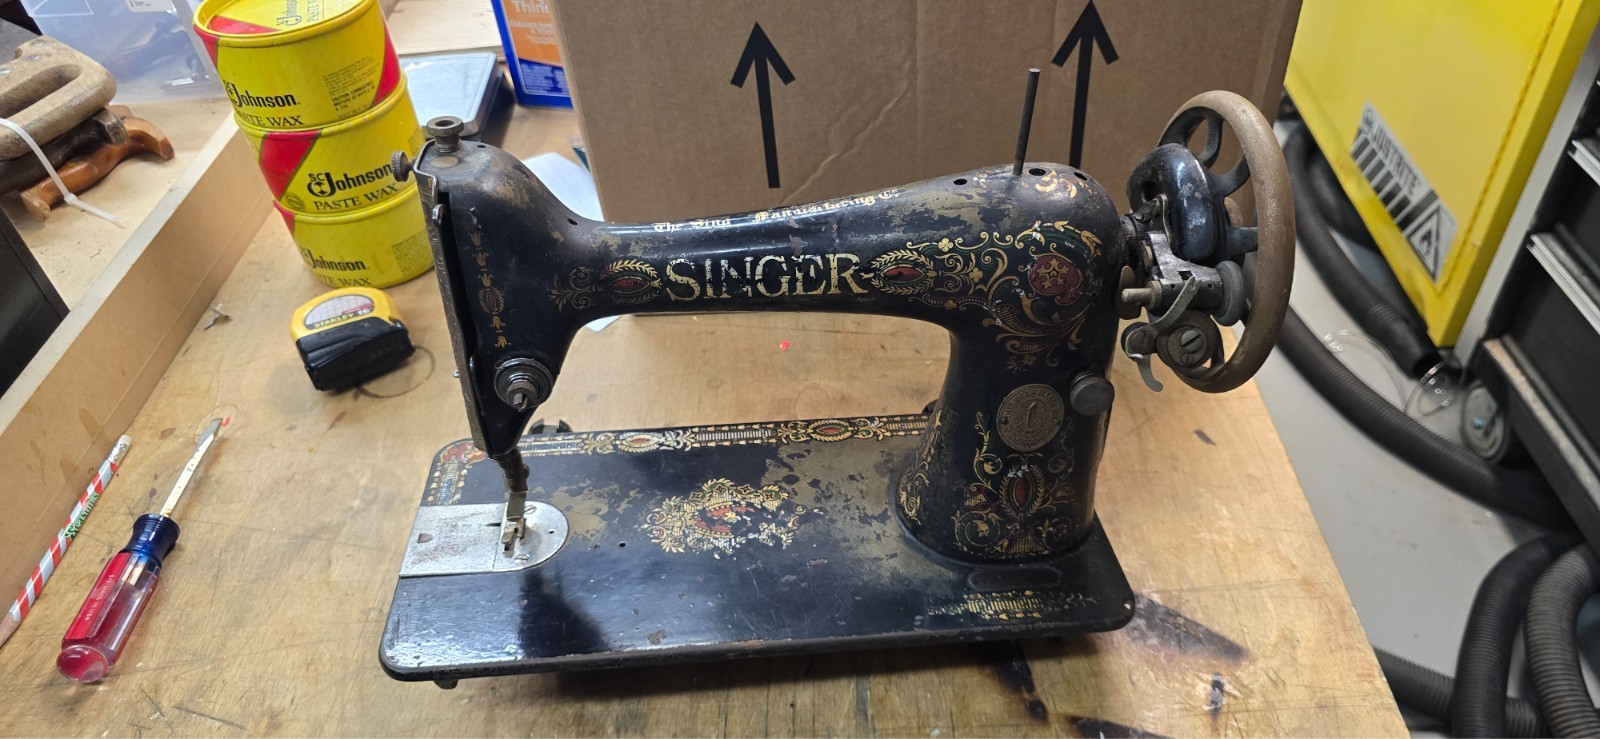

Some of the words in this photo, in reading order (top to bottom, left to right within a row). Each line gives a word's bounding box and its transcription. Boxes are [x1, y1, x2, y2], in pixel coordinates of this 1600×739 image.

[265, 115, 304, 127] WAX
[307, 164, 393, 198] Johnson
[313, 196, 362, 210] PASTE
[363, 183, 399, 202] WAX
[665, 253, 869, 301] SINGER
[313, 312, 355, 329] STANLEY
